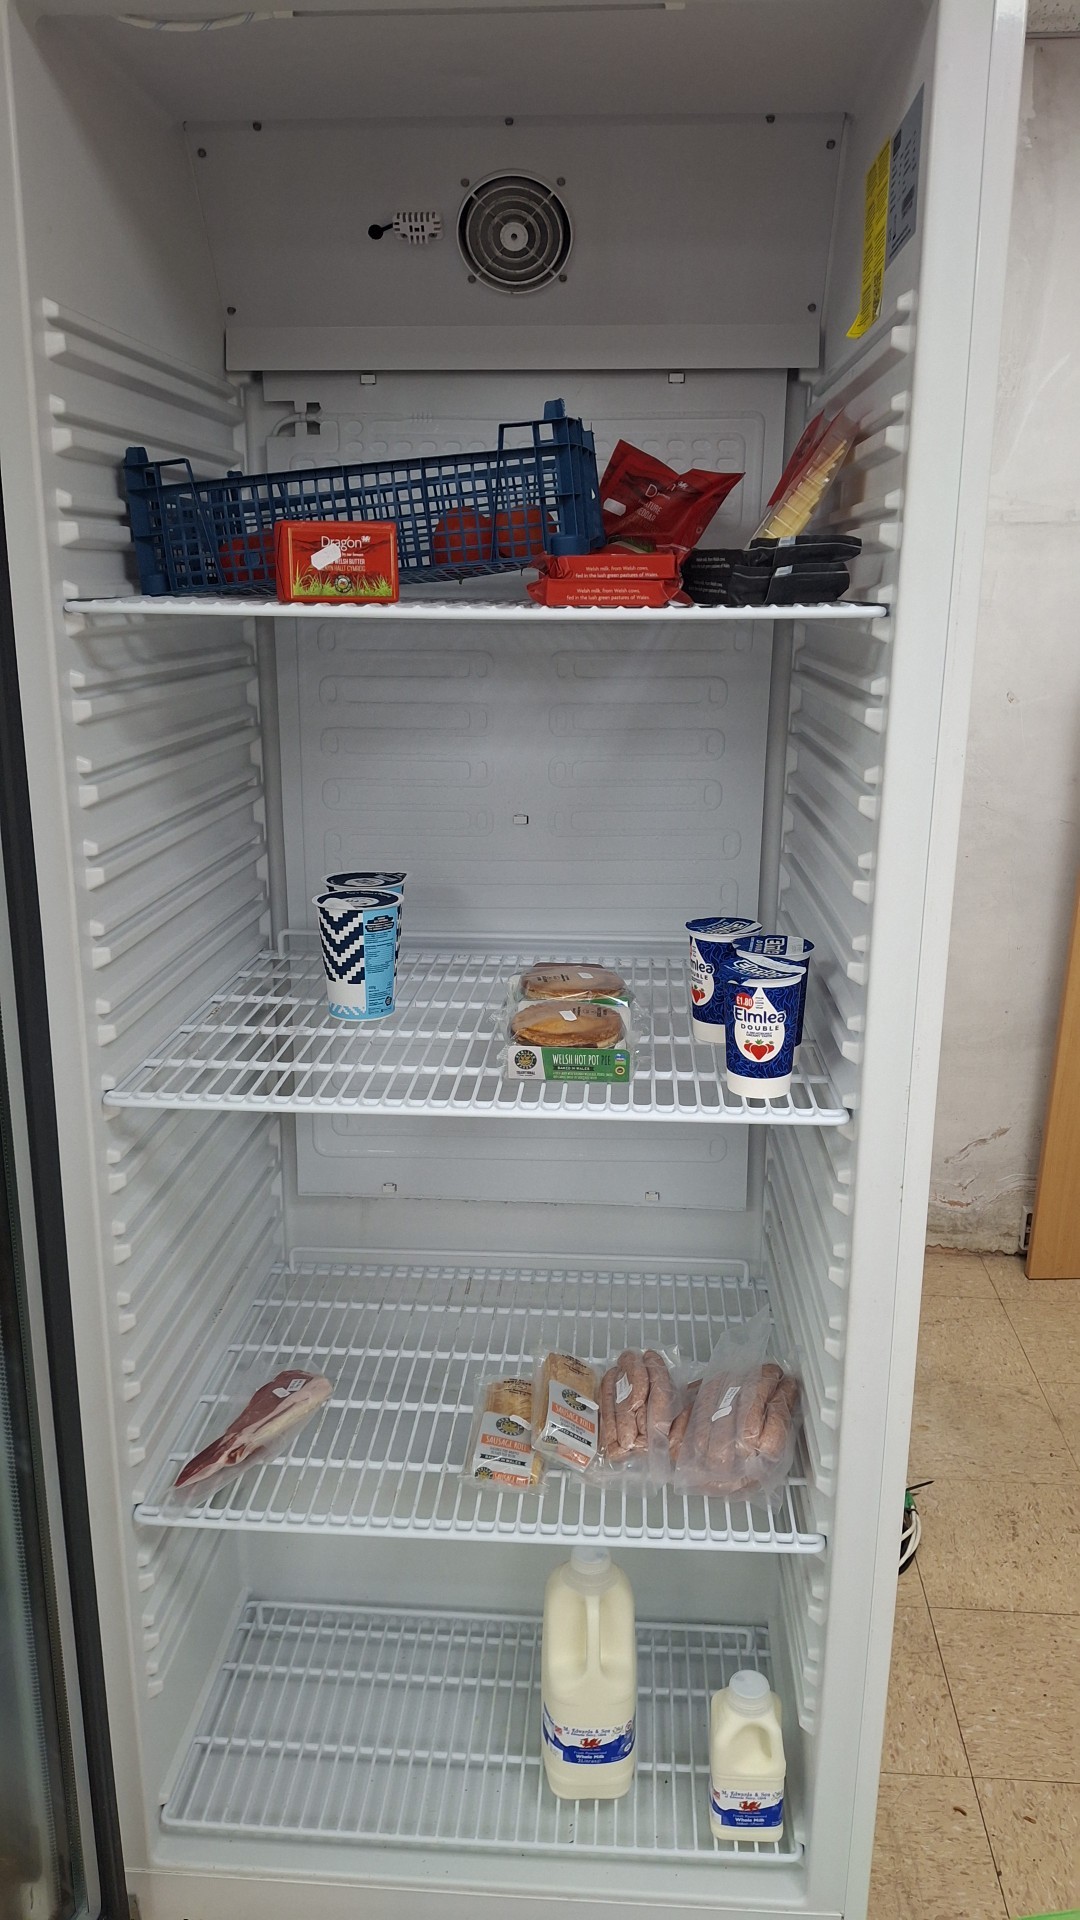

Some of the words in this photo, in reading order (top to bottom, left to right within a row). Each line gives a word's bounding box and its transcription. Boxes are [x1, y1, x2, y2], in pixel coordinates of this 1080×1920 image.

[321, 535, 362, 551] Dragon
[690, 959, 714, 975] mlea
[736, 995, 753, 1007] £1.80
[734, 1006, 786, 1024] Elmlea
[740, 1023, 780, 1032] DOUBLE
[552, 1054, 573, 1065] WELSH
[574, 1054, 587, 1065] HOT
[588, 1055, 600, 1066] POT
[486, 1435, 513, 1448] SAUSAGE
[513, 1442, 528, 1452] ROLL
